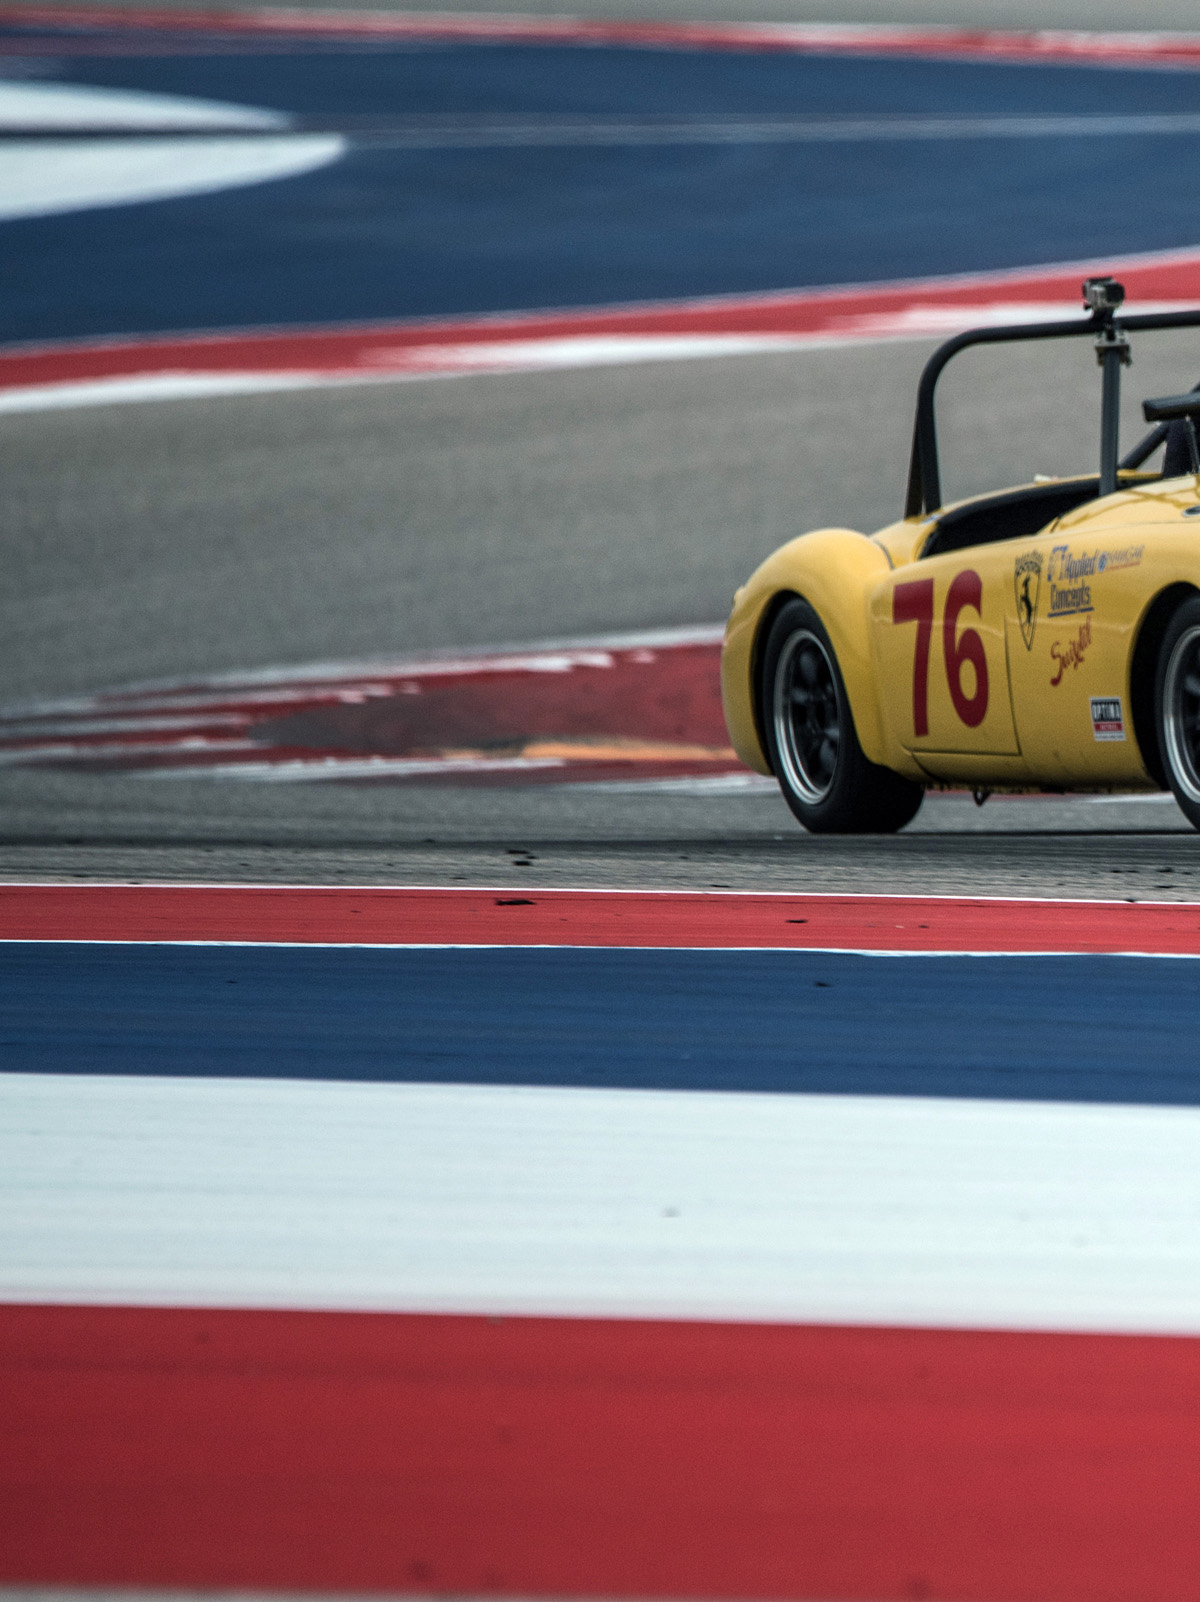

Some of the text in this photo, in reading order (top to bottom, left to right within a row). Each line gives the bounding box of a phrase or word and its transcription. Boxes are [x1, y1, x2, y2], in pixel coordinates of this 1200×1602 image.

[1065, 549, 1099, 584] Applied
[1051, 578, 1091, 611] Concepts
[893, 569, 989, 738] 76
[1091, 704, 1122, 720] OPTIMA
